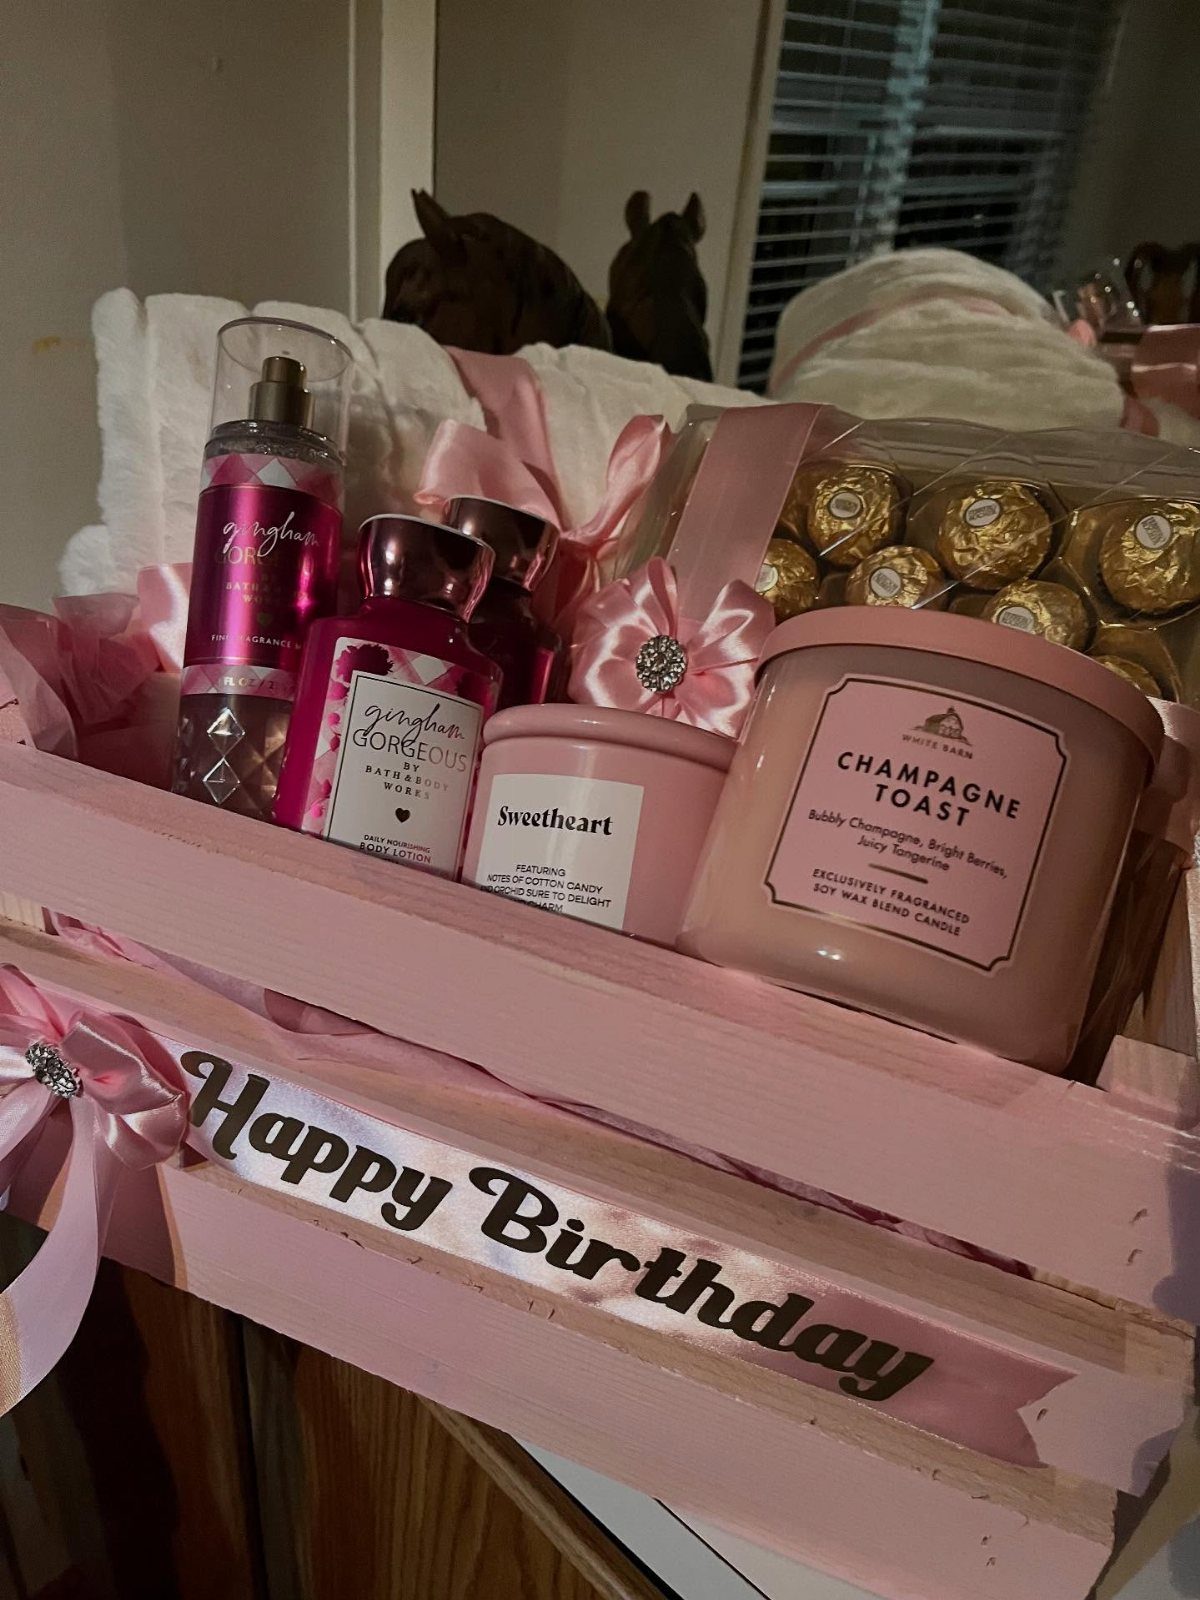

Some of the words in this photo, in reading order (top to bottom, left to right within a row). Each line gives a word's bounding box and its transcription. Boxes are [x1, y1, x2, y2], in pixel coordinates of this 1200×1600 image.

[223, 511, 320, 557] gingham
[364, 703, 464, 747] gingham
[352, 728, 468, 772] GORGEOUS
[902, 733, 938, 750] WHITE
[943, 743, 973, 760] BARN
[365, 765, 401, 780] BATH
[404, 774, 412, 783] &
[415, 776, 449, 792] BODY
[403, 762, 420, 772] BY
[383, 781, 430, 800] WORKS
[837, 751, 1021, 819] CHAMPAGNE
[498, 805, 613, 836] Sweetheart
[875, 783, 970, 826] TOAST
[360, 842, 390, 854] BODY
[393, 848, 431, 864] LOTION
[364, 834, 385, 843] DAILY
[386, 839, 431, 854] NOURISHING
[808, 810, 847, 828] Bubbly
[849, 816, 924, 848] Champagne,
[928, 839, 964, 862] Bright
[968, 852, 1008, 879] Berries,
[857, 836, 888, 854] Juicy
[892, 844, 950, 871] Tangerine
[487, 874, 511, 883] NOTES
[512, 875, 524, 884] OF
[525, 877, 564, 889] COTTON
[567, 882, 603, 894] CANDY
[516, 864, 566, 877] FEATURING
[493, 885, 525, 896] ORCHID
[526, 888, 550, 898] SURE
[552, 891, 565, 901] TO
[567, 894, 611, 908] DELIGHT
[812, 868, 886, 895] EXCLUSIVELY
[891, 889, 969, 924] FRAGRANCED
[813, 883, 837, 897] SOY
[842, 889, 867, 905] WAX
[872, 898, 910, 918] BLEND
[914, 912, 960, 936] CANDLE
[180, 1050, 453, 1231] Happy
[468, 1165, 935, 1402] Birthday
